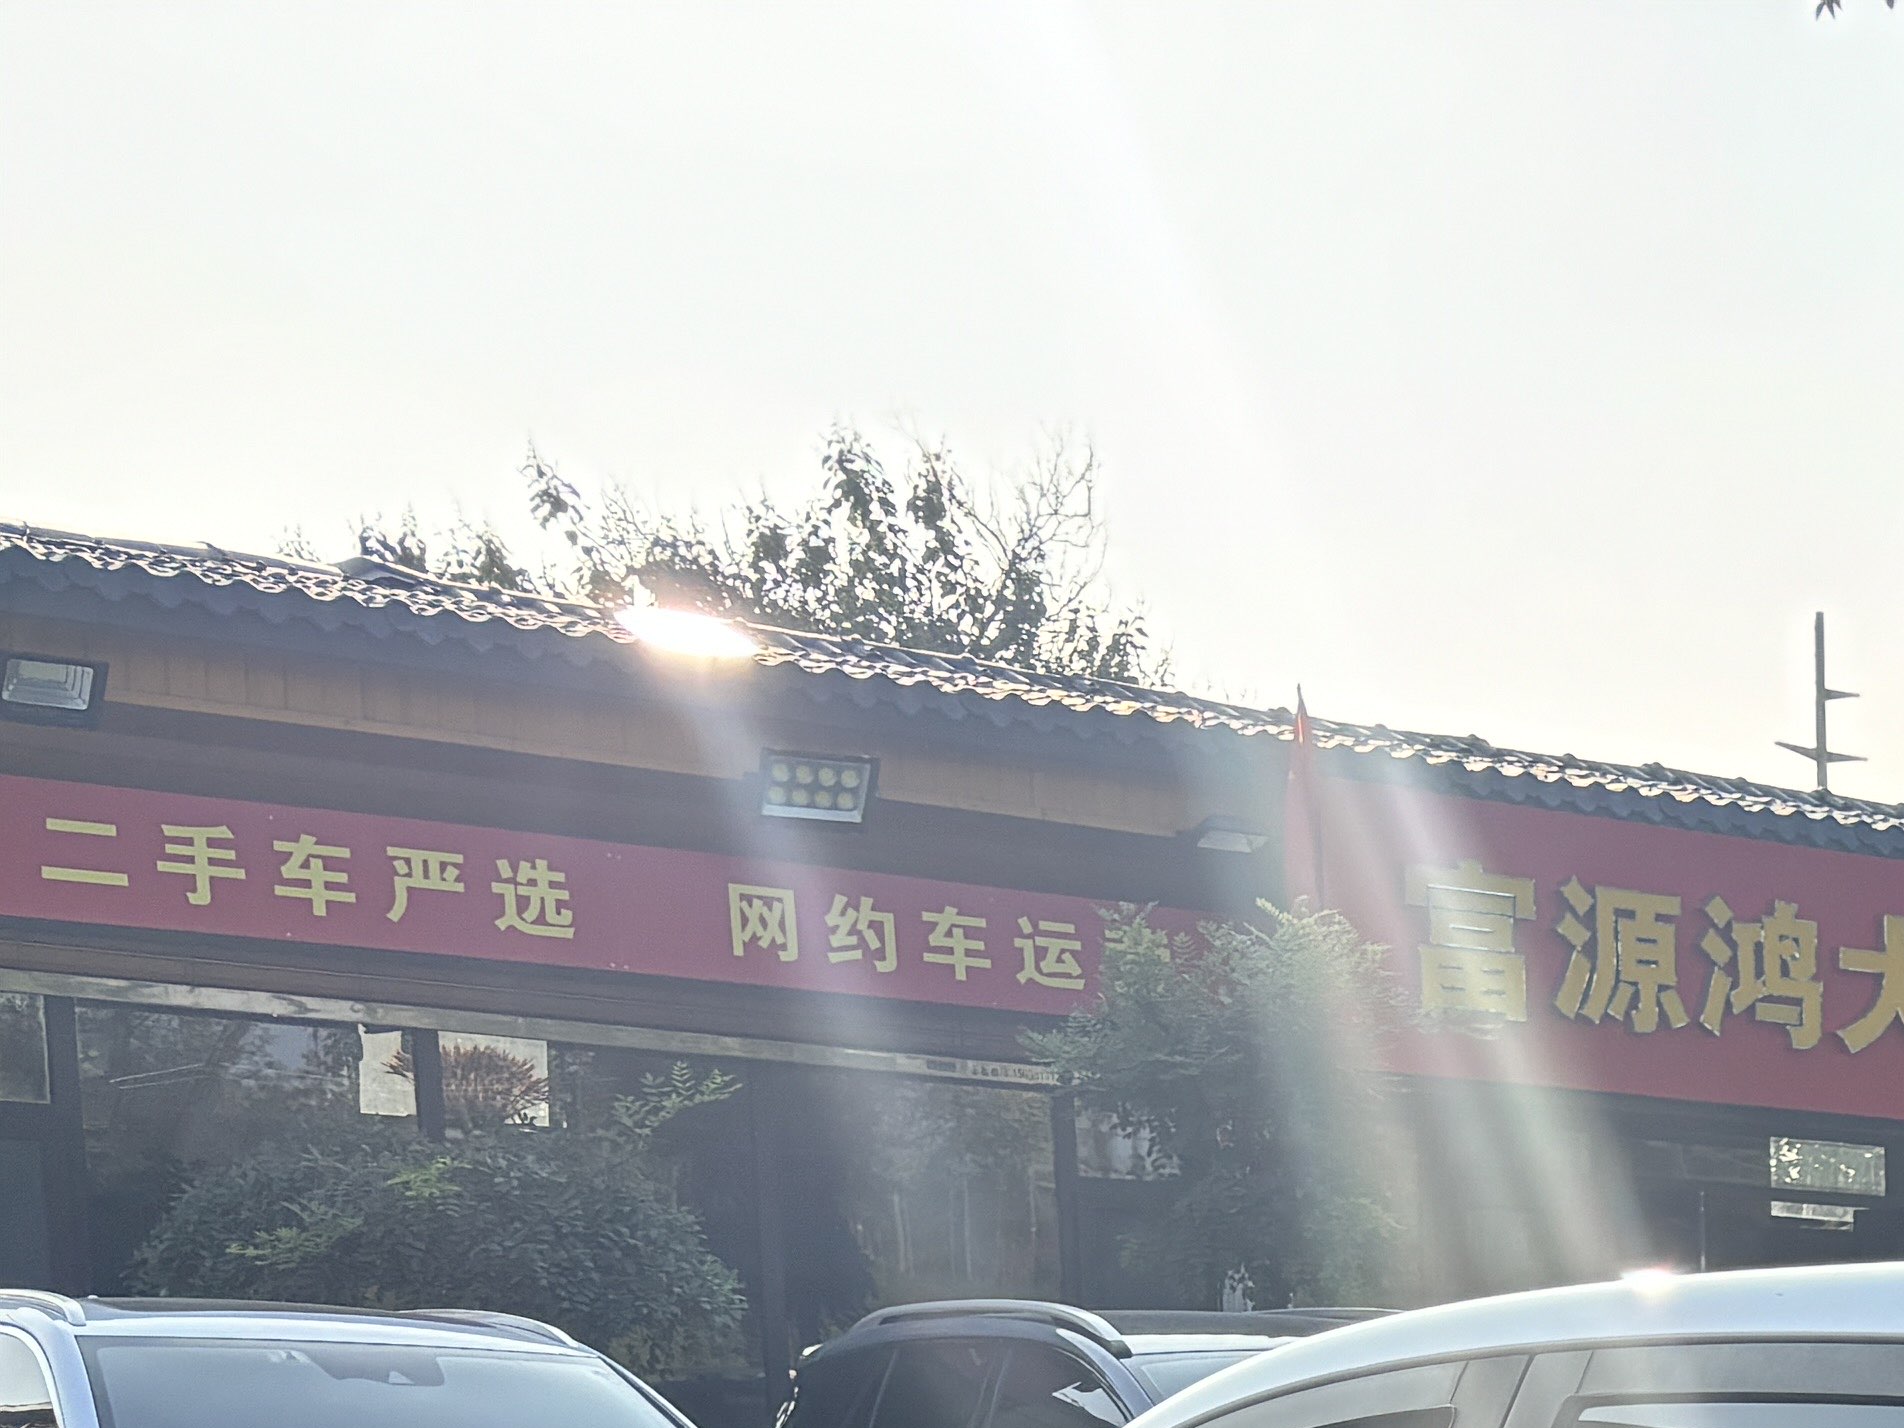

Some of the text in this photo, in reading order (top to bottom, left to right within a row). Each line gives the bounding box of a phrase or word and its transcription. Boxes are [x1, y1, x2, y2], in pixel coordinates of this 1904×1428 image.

[40, 816, 576, 940] 二手车严选
